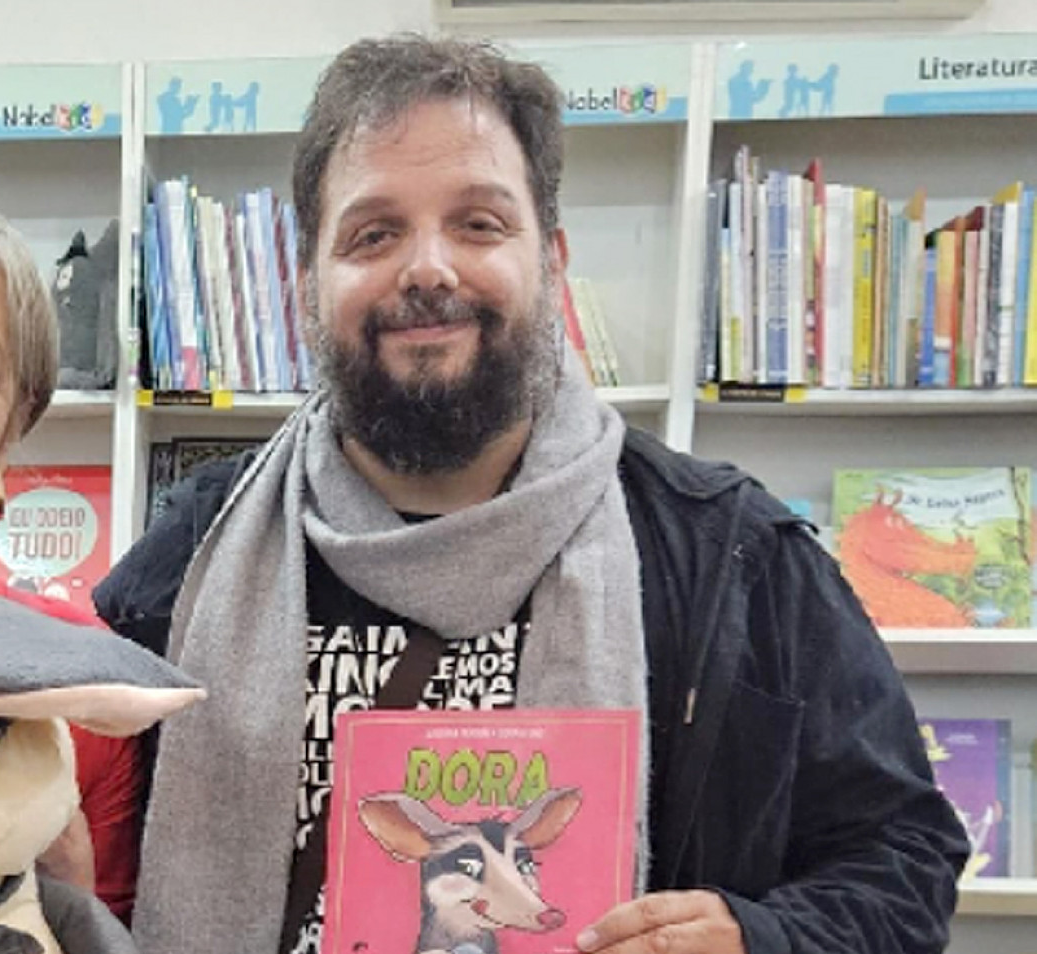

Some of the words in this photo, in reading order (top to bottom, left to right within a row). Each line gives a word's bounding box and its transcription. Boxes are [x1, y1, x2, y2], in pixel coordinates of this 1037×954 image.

[918, 57, 1037, 80] Literatura
[8, 531, 83, 560] TUDO!
[404, 746, 551, 808] DORA
